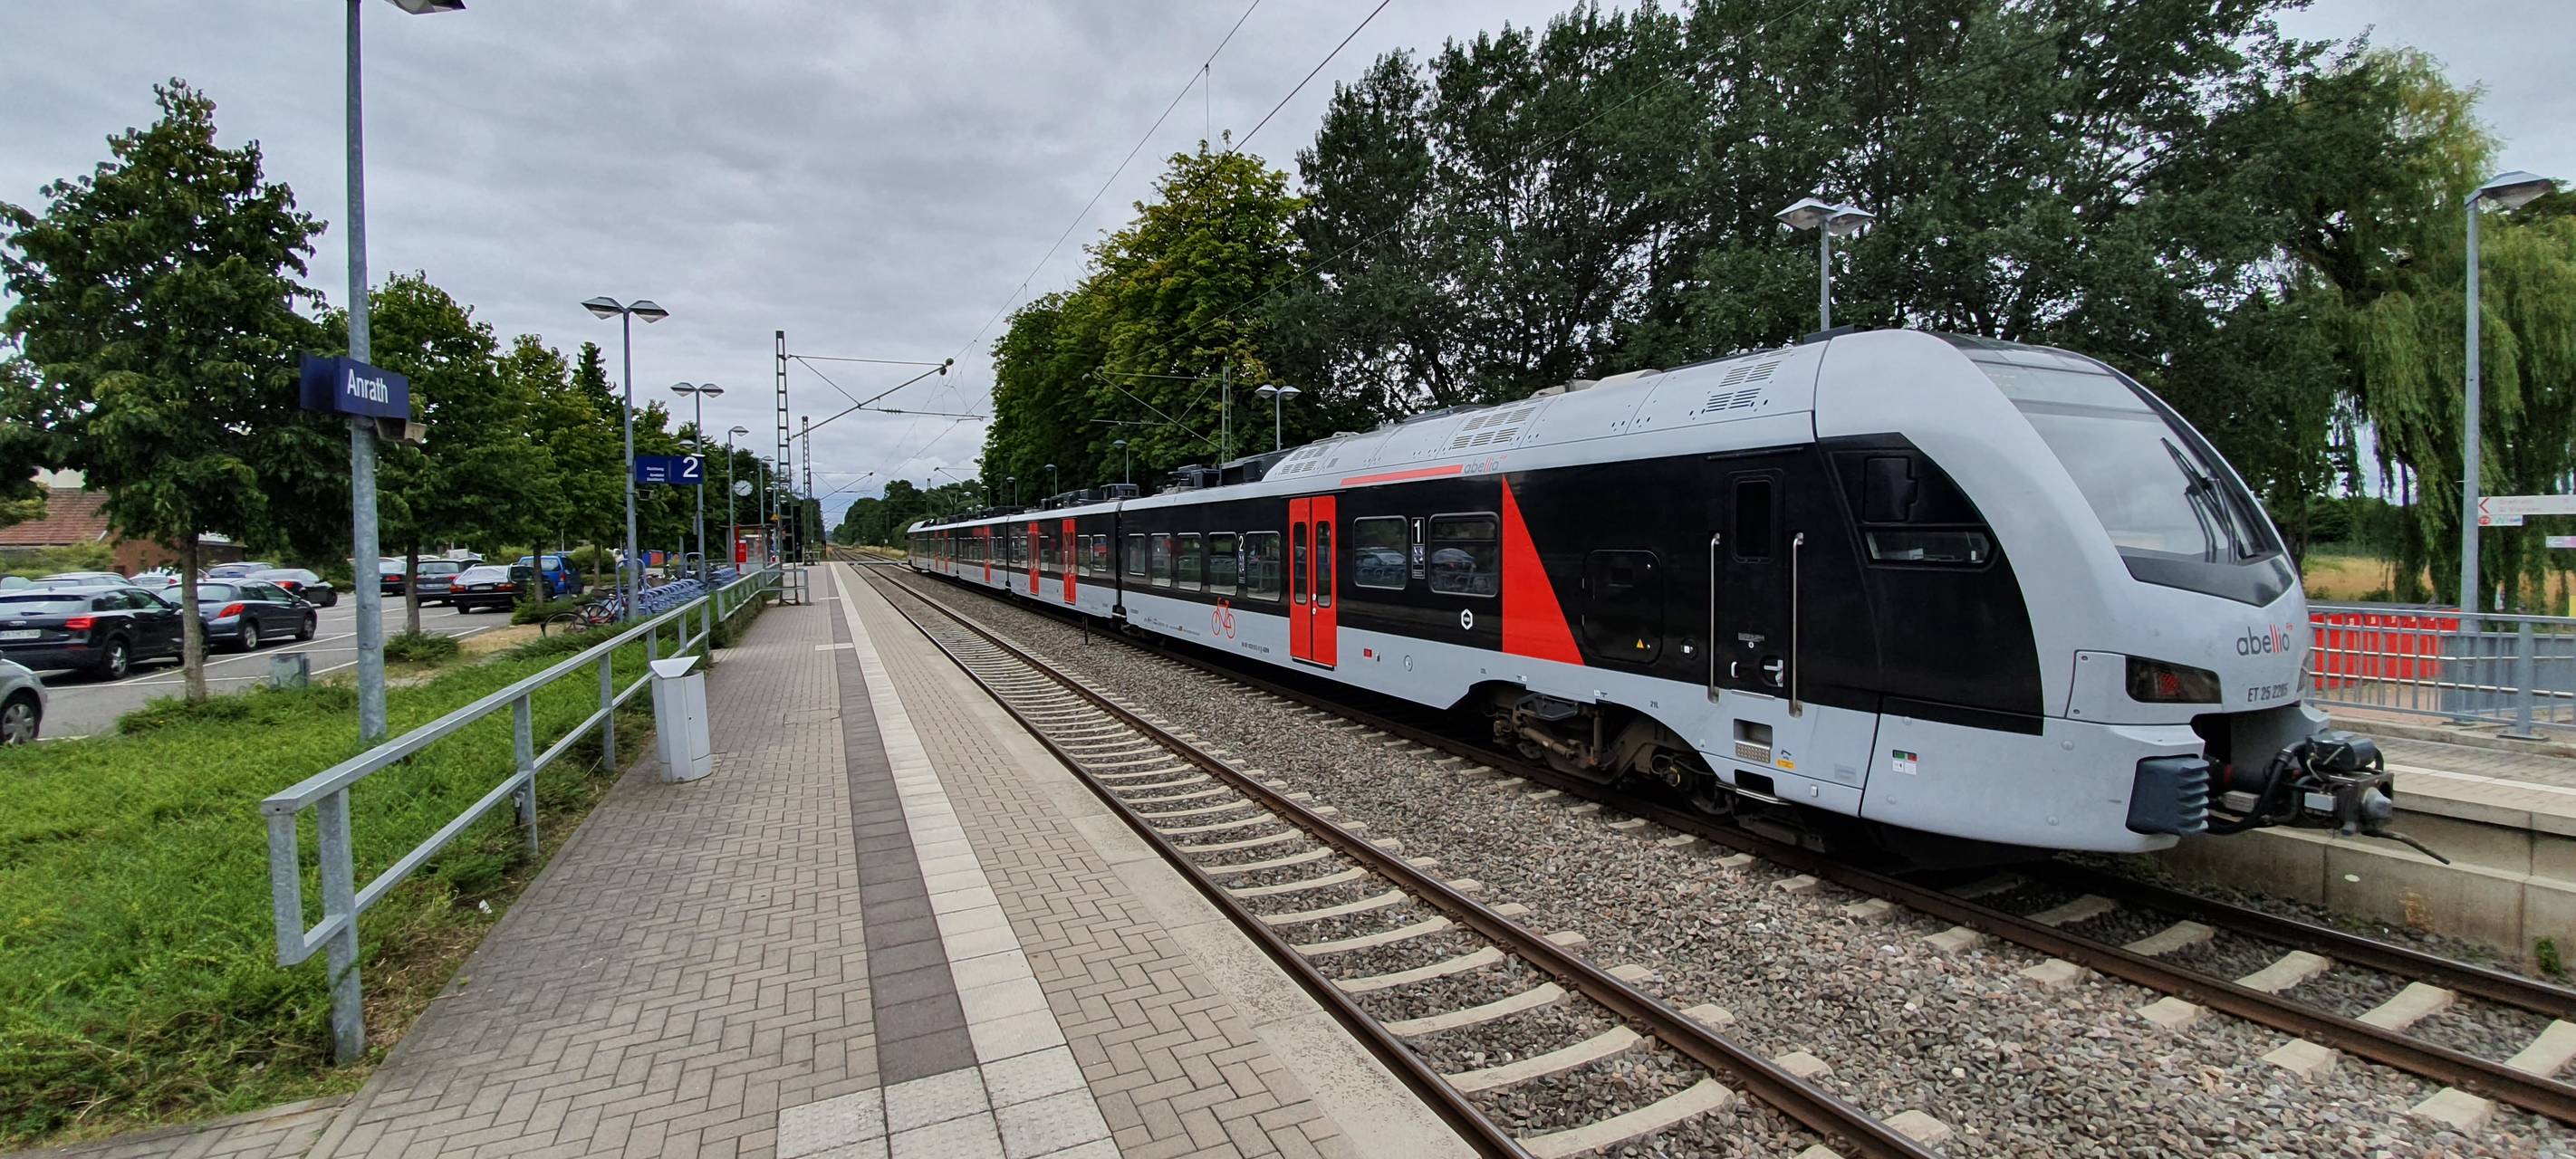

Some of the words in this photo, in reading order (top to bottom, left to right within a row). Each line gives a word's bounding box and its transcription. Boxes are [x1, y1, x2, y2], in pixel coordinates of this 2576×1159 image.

[347, 368, 389, 404] Anrath
[682, 456, 698, 478] 2
[1464, 456, 1500, 474] abellio
[1414, 519, 1421, 543] 1
[1238, 535, 1245, 552] 2
[2236, 623, 2290, 656] abellio
[2247, 687, 2259, 703] ET
[2261, 685, 2271, 701] 25
